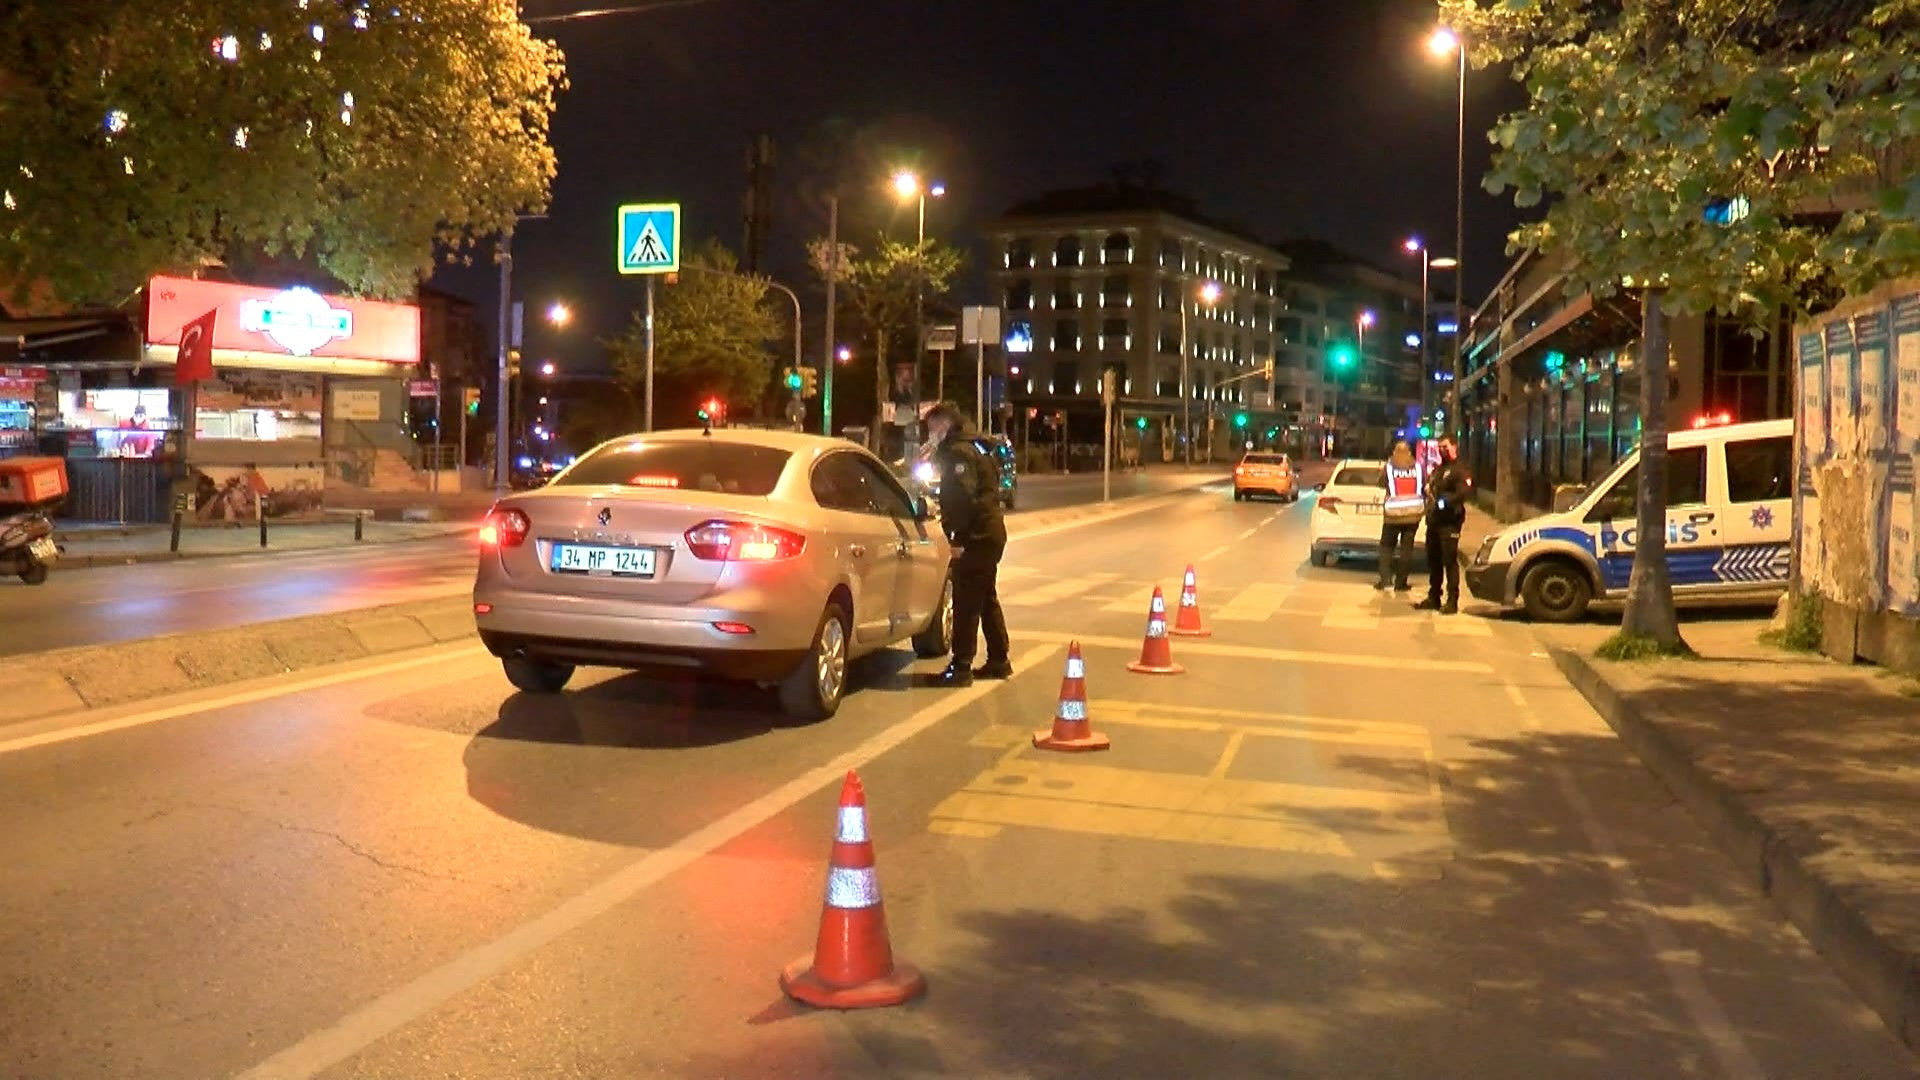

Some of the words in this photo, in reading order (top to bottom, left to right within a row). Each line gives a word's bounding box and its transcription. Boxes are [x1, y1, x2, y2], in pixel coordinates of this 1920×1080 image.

[564, 549, 581, 567] 34
[588, 550, 606, 569] MP
[615, 552, 648, 570] 1244
